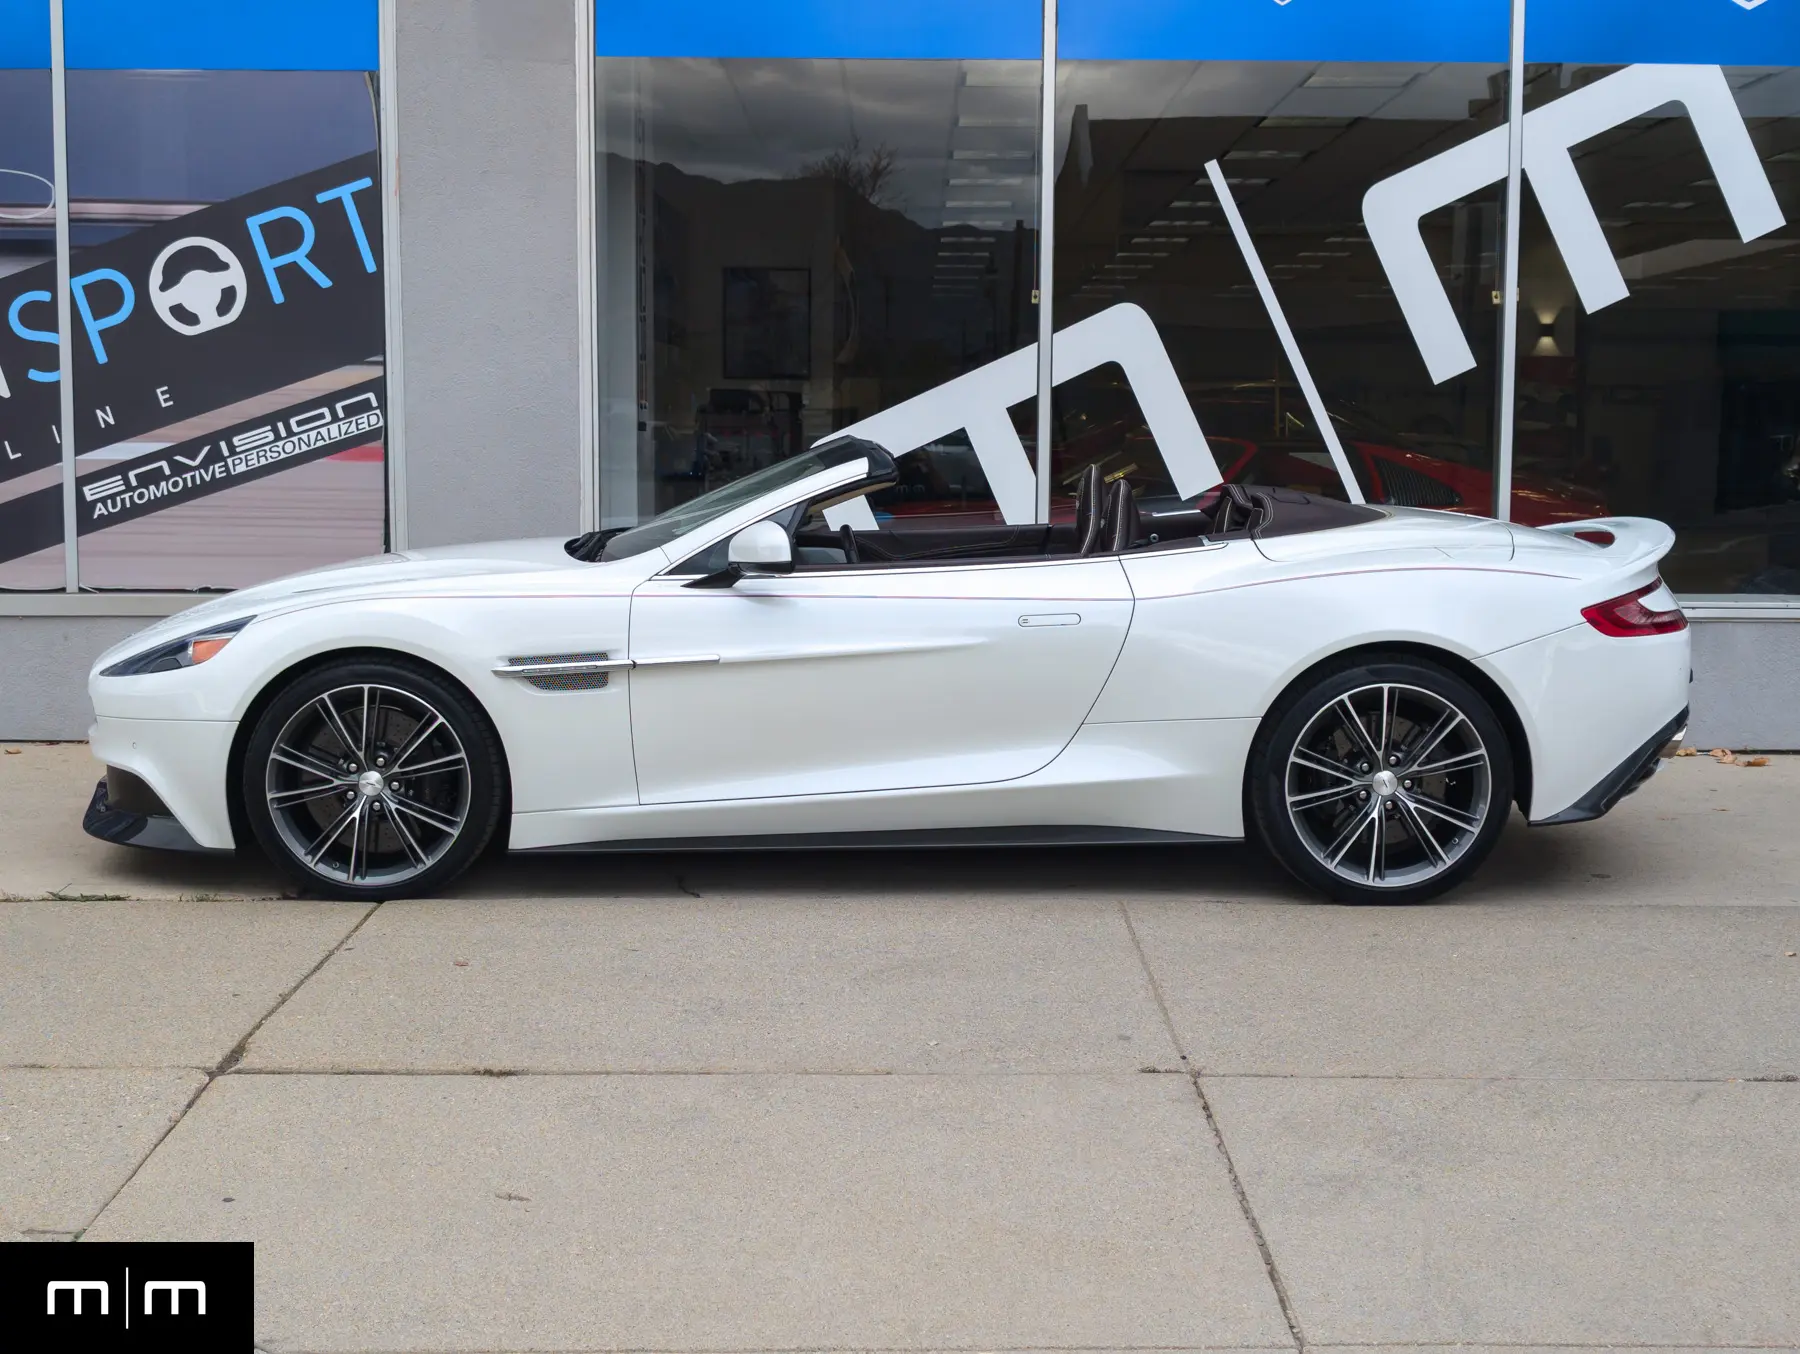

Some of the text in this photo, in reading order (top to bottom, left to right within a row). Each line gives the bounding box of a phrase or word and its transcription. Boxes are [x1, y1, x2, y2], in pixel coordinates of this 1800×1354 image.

[0, 177, 377, 398] SPORT
[93, 411, 380, 519] AUTOMOTIVE PERSONALIZED
